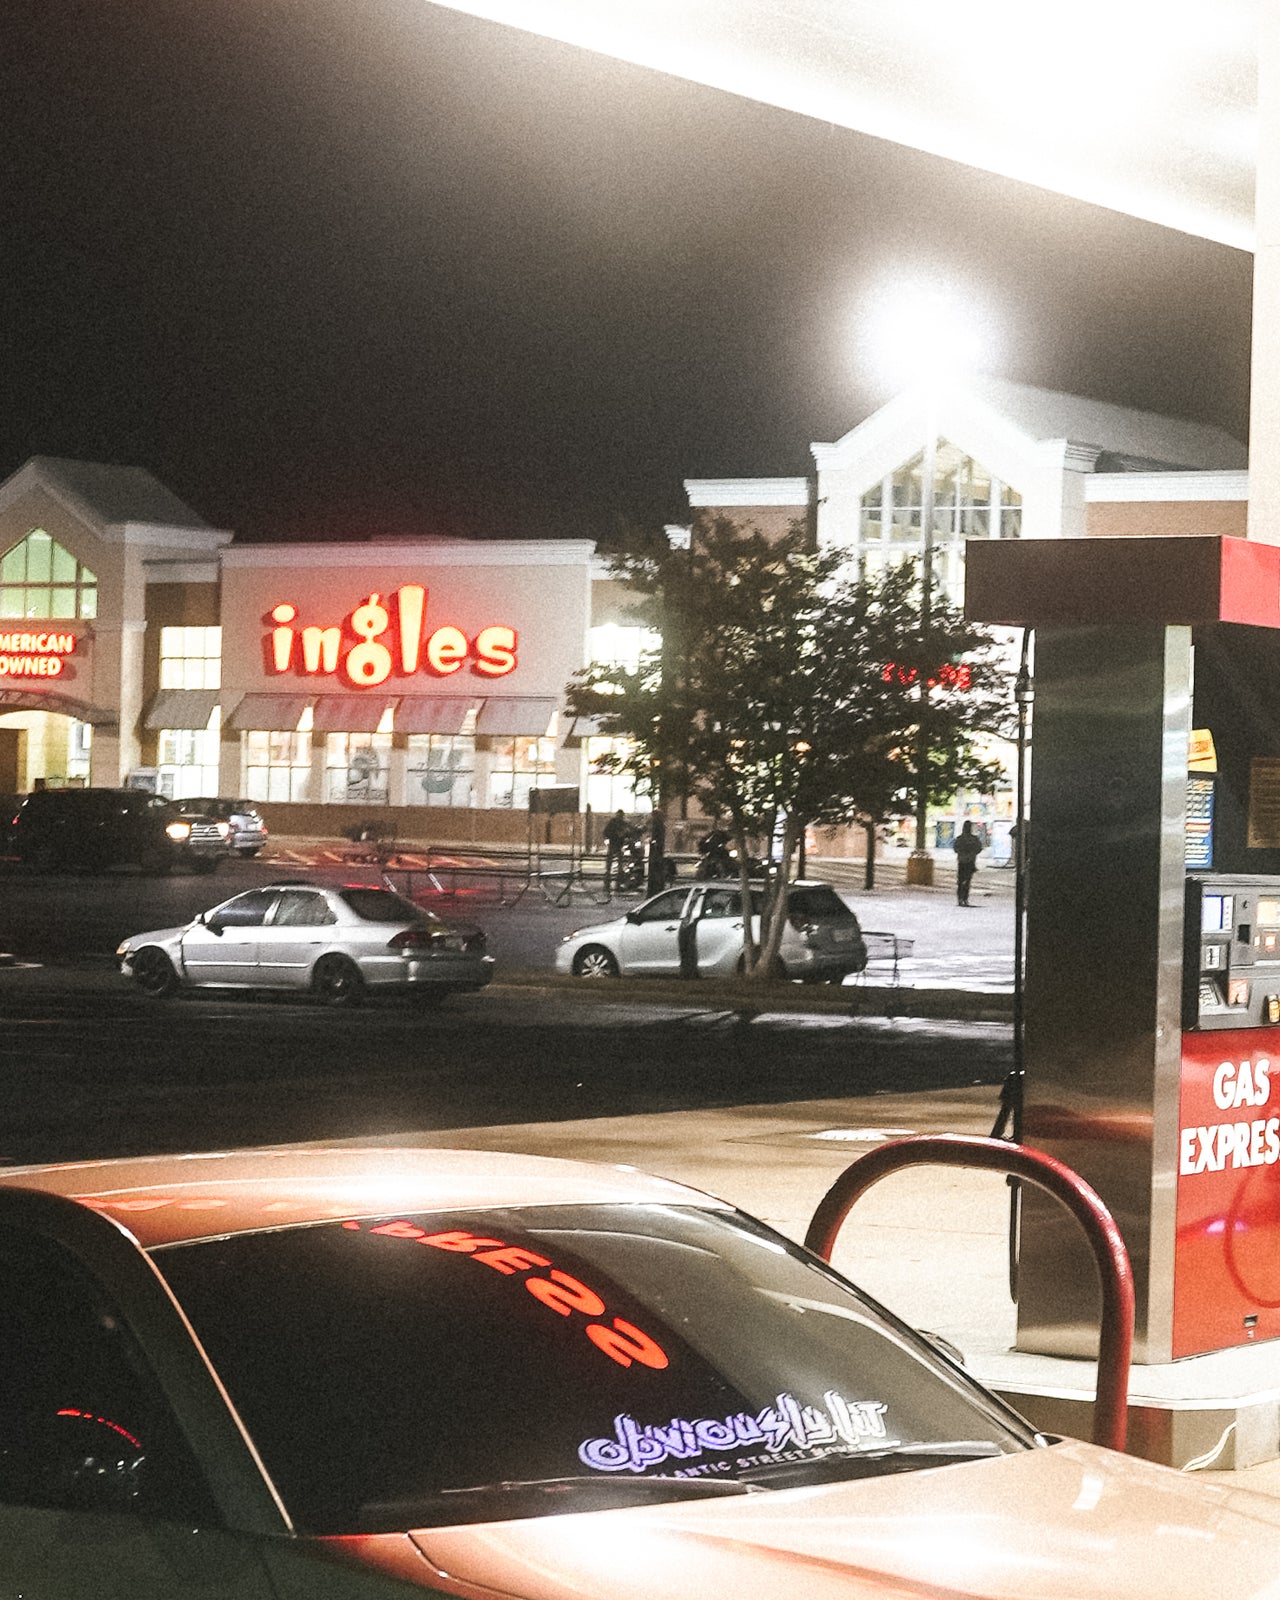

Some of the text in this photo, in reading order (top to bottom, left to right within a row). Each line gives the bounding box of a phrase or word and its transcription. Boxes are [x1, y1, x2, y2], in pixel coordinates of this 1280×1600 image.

[271, 584, 517, 687] ingles
[1213, 1058, 1271, 1110] GAS
[736, 1449, 807, 1468] STREET
